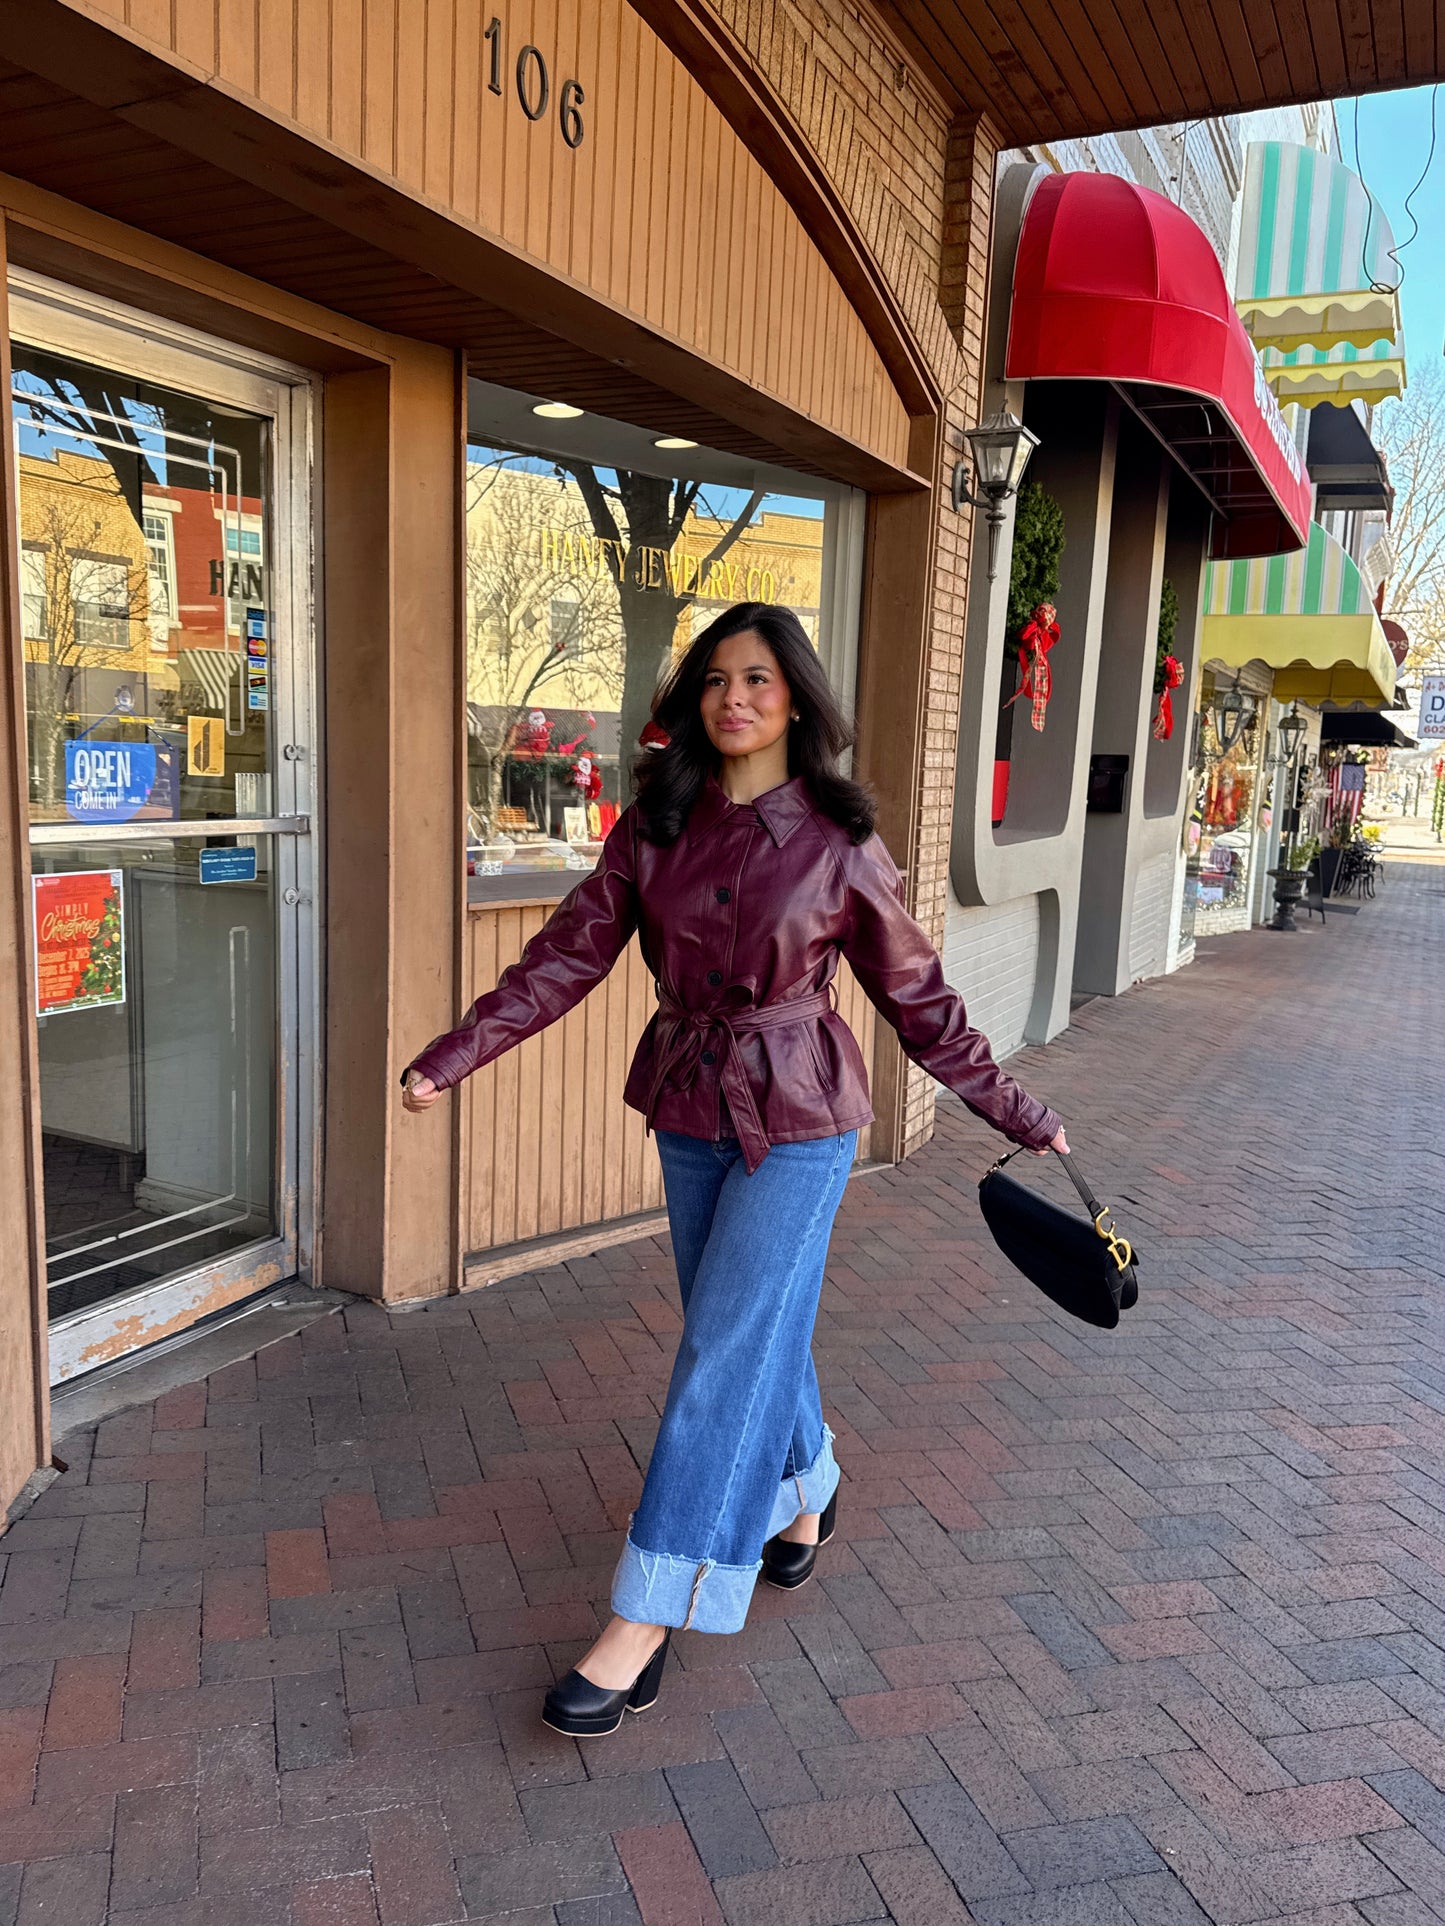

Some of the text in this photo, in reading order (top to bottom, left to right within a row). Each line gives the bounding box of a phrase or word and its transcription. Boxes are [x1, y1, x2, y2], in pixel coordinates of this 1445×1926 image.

[484, 17, 585, 149] 106
[633, 544, 739, 601] JEWELRY
[251, 661, 265, 669] VISA
[74, 749, 131, 788] OPEN
[74, 791, 117, 810] COME IN
[41, 911, 100, 942] Christmas
